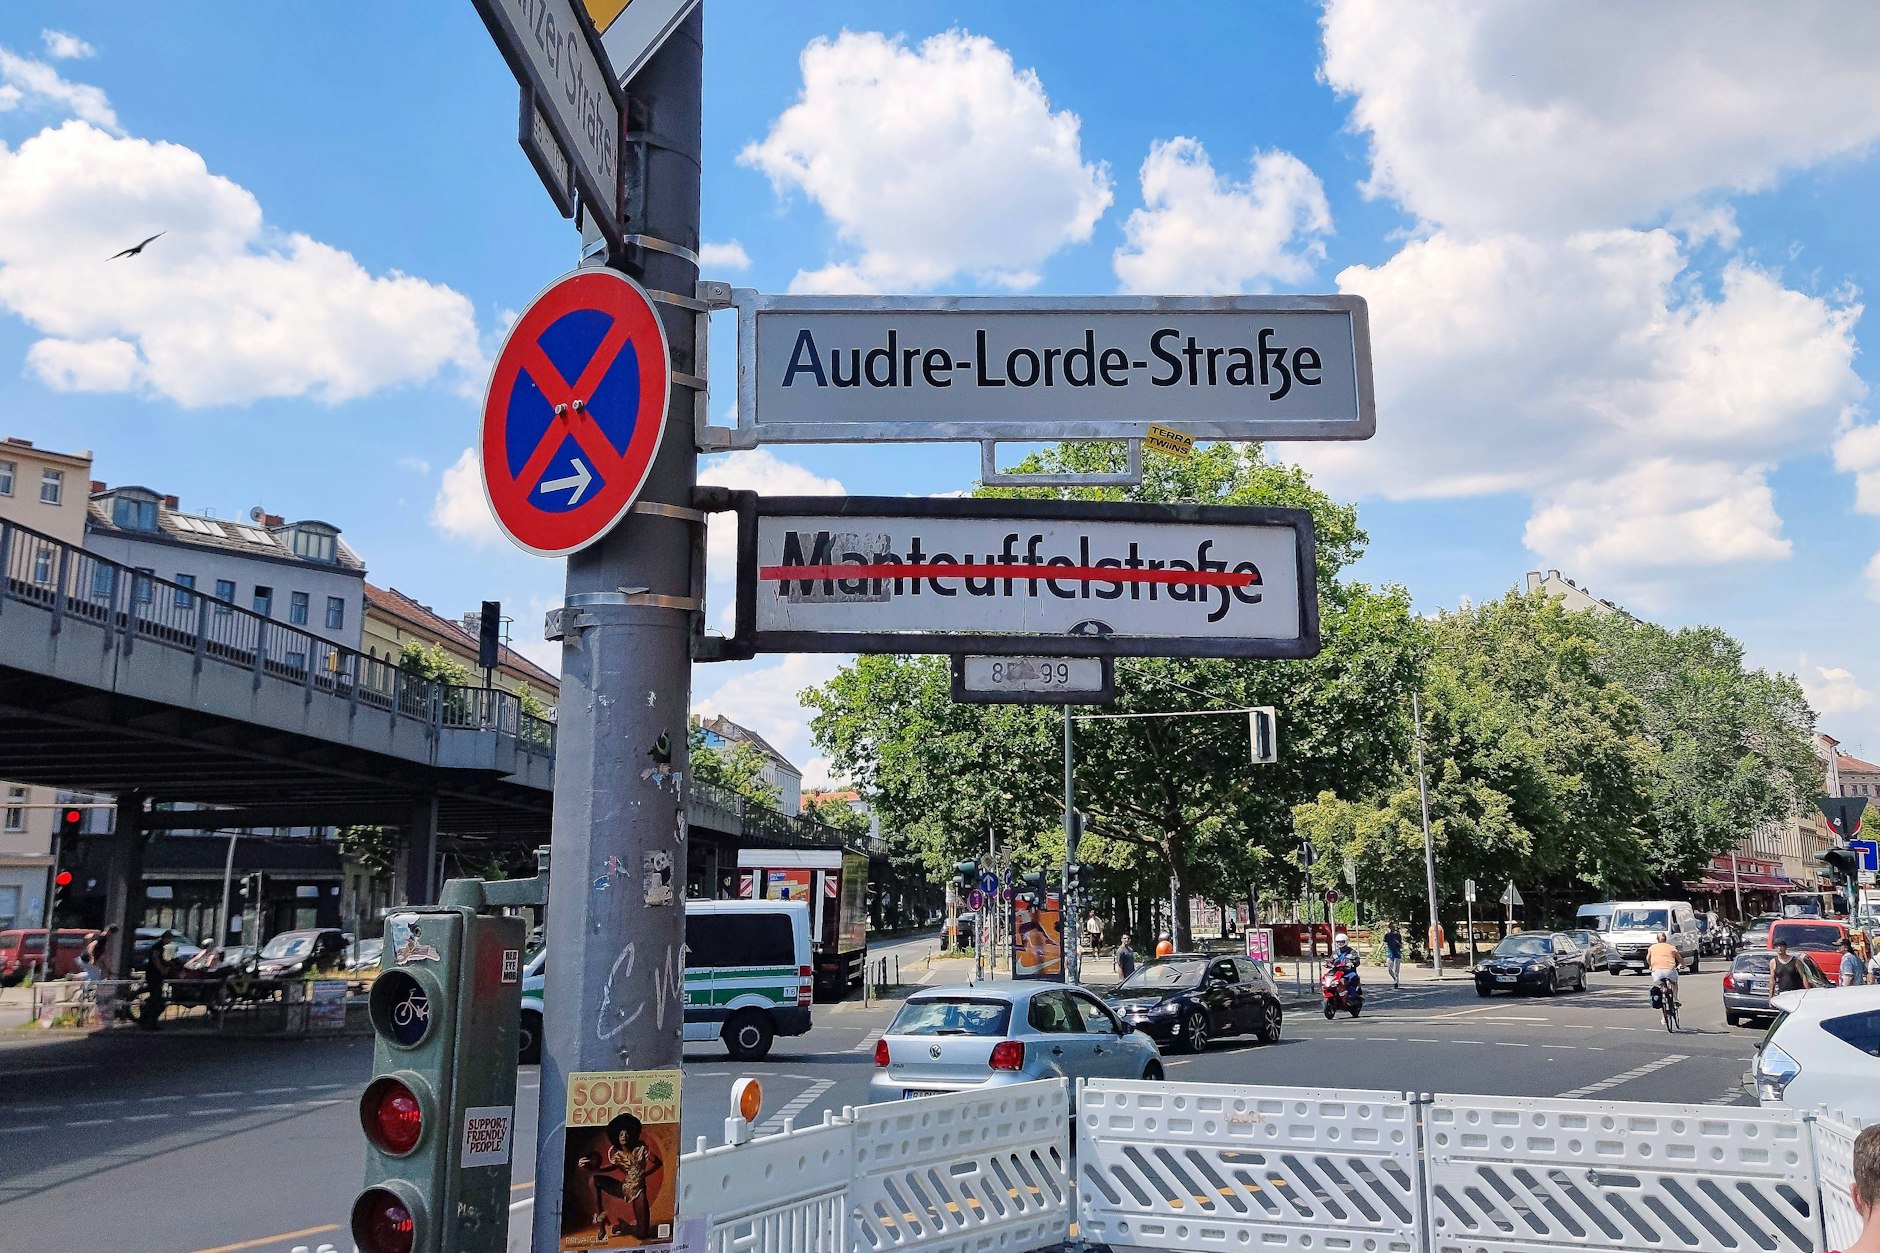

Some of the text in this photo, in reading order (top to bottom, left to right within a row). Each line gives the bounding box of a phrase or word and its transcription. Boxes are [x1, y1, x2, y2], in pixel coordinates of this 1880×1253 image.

[565, 31, 612, 177] Straße
[781, 328, 1322, 401] Audre-Lorde-Straße
[1148, 436, 1189, 454] TWIINS
[1151, 426, 1192, 445] TERRA
[778, 531, 1264, 623] Manteuffelstraße
[1041, 662, 1070, 684] 99
[503, 971, 517, 981] MOB
[505, 961, 516, 971] EYE
[573, 1081, 643, 1107] SOUL
[467, 1127, 508, 1145] FRIENDLY
